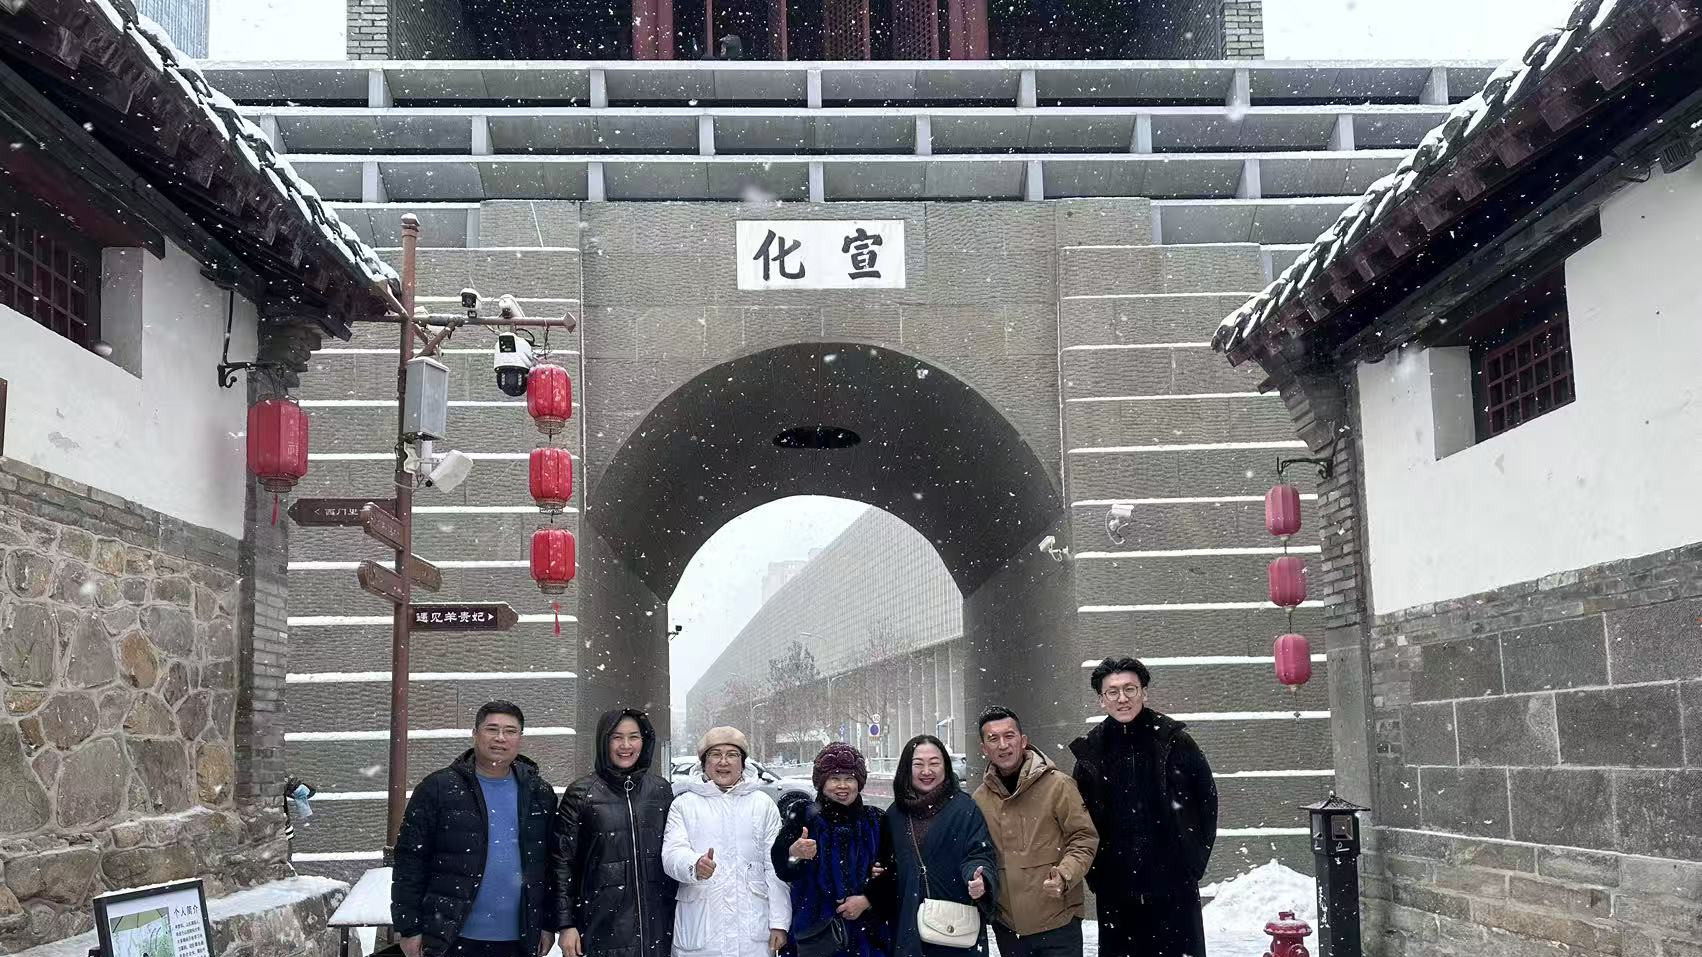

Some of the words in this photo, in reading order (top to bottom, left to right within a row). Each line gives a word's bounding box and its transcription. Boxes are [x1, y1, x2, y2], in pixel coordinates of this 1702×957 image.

[415, 611, 486, 623] 遇见羊贵妃
[173, 904, 199, 919] 个人简介
